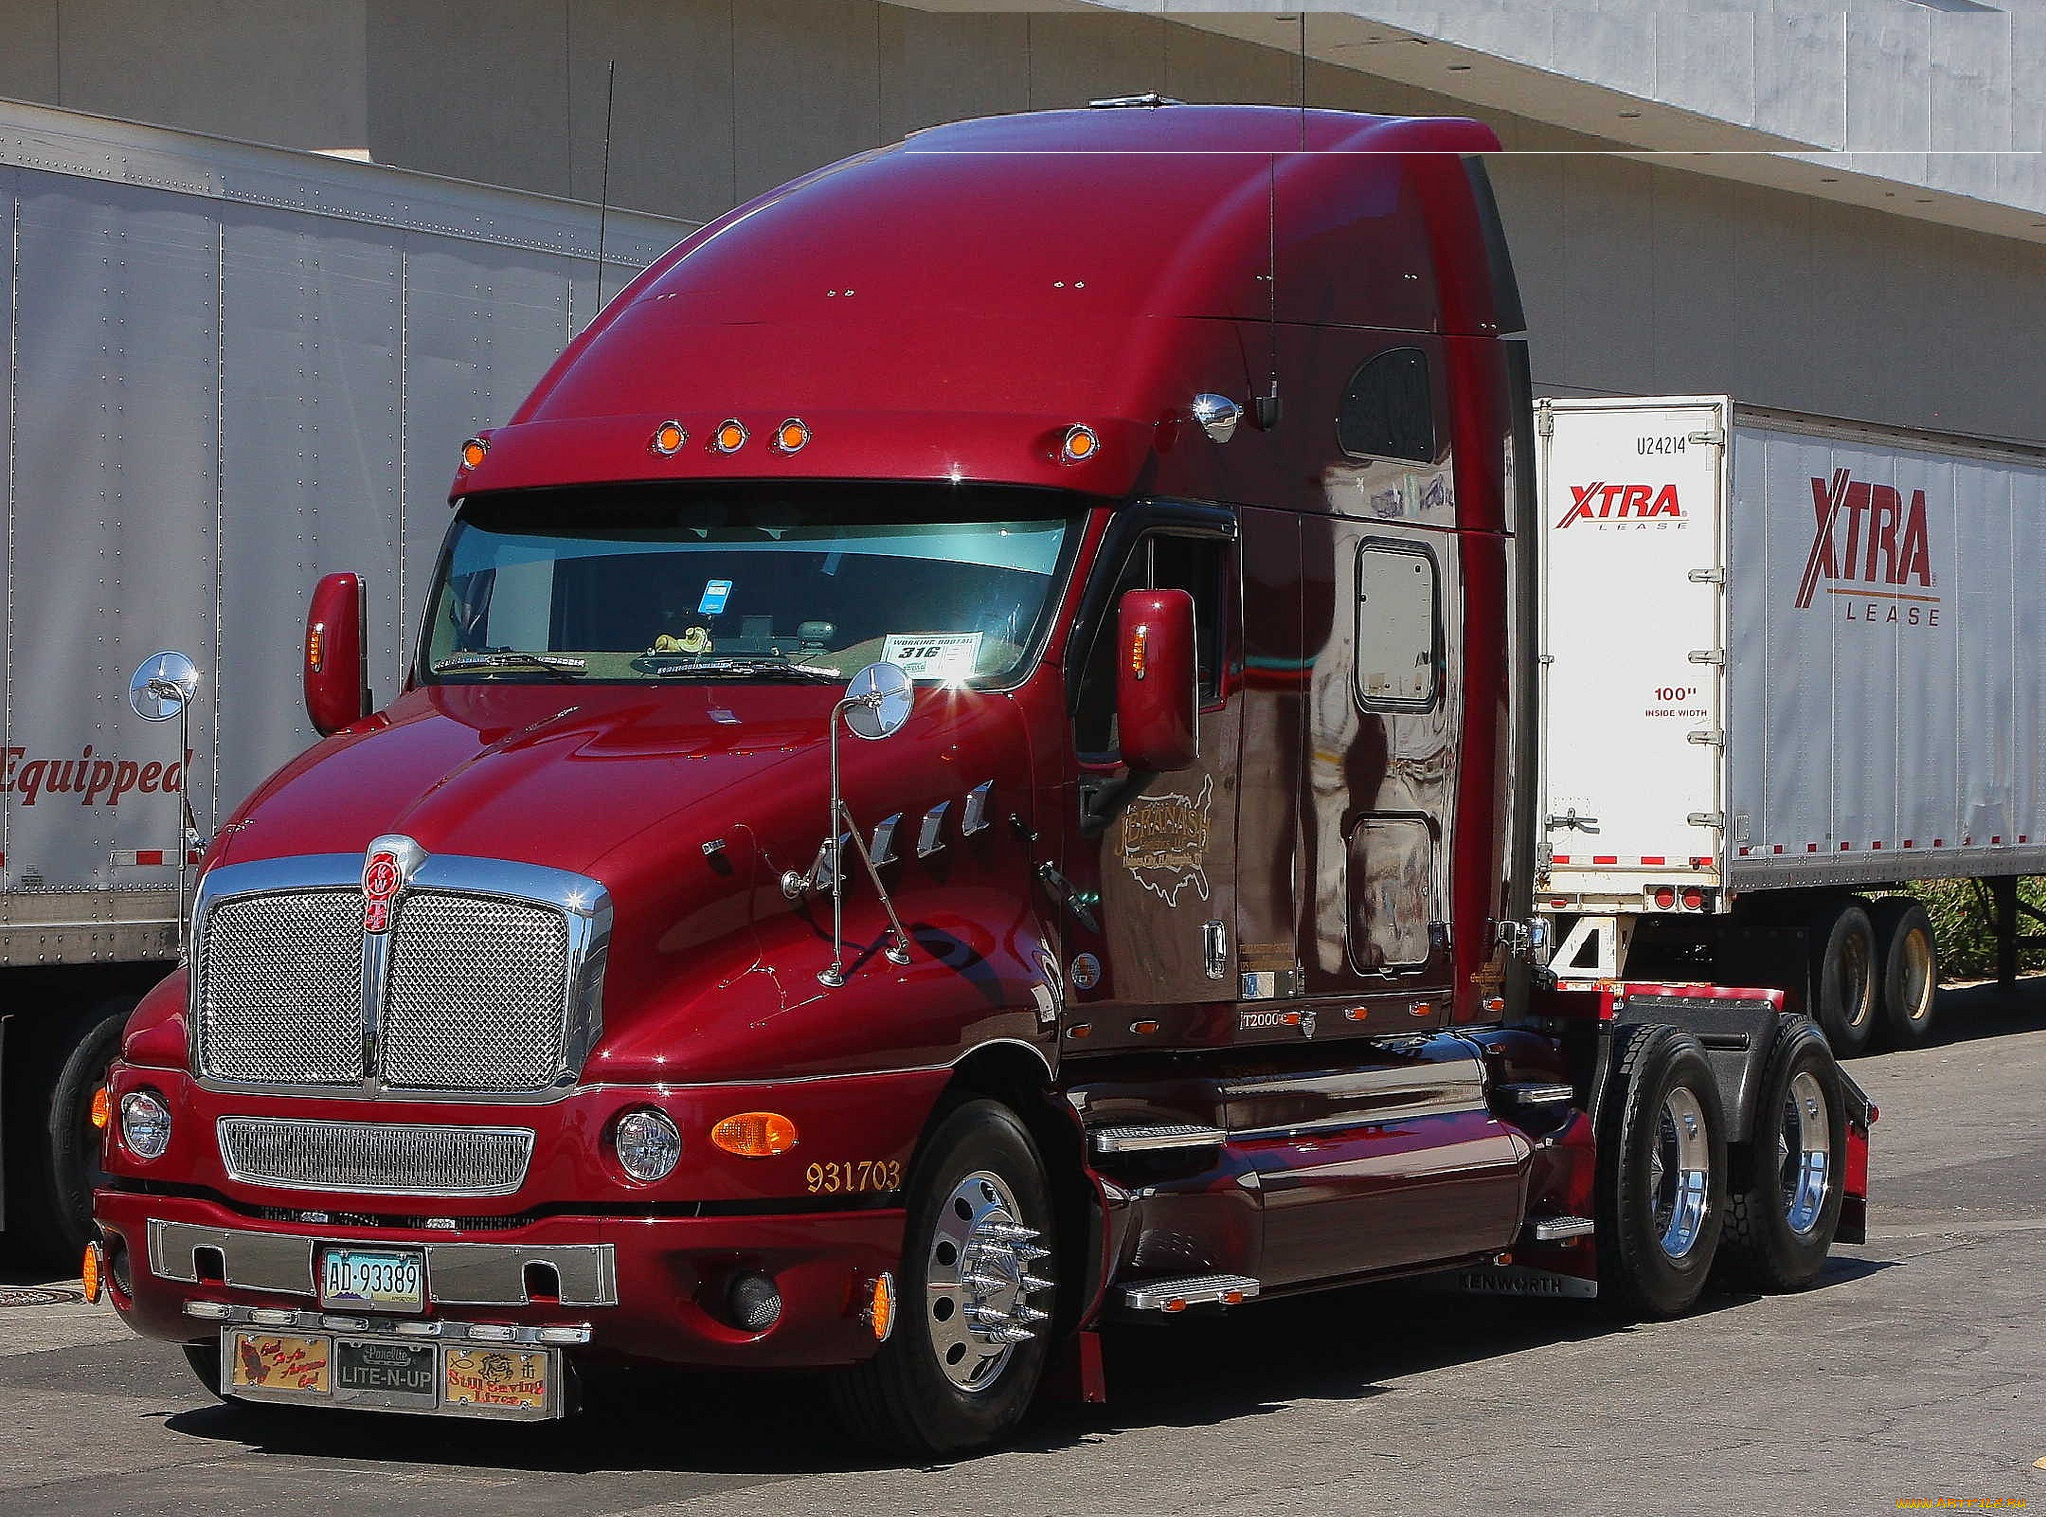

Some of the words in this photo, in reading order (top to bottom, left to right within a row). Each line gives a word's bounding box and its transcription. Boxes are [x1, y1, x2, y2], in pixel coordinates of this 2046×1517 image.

[1637, 436, 1685, 455] U24214
[1553, 481, 1680, 529] XTRA
[1599, 522, 1687, 531] LEASE
[1795, 468, 1932, 608] XTRA
[1846, 602, 1940, 626] LEASE
[898, 646, 941, 659] 316
[1645, 709, 1676, 717] INSIDE
[1677, 709, 1707, 717] WIDTH
[0, 744, 194, 806] Equipped
[1244, 1012, 1279, 1027] T2000
[806, 1160, 900, 1192] 931703
[342, 1366, 432, 1388] LITE-N-UP
[447, 1369, 484, 1391] Still
